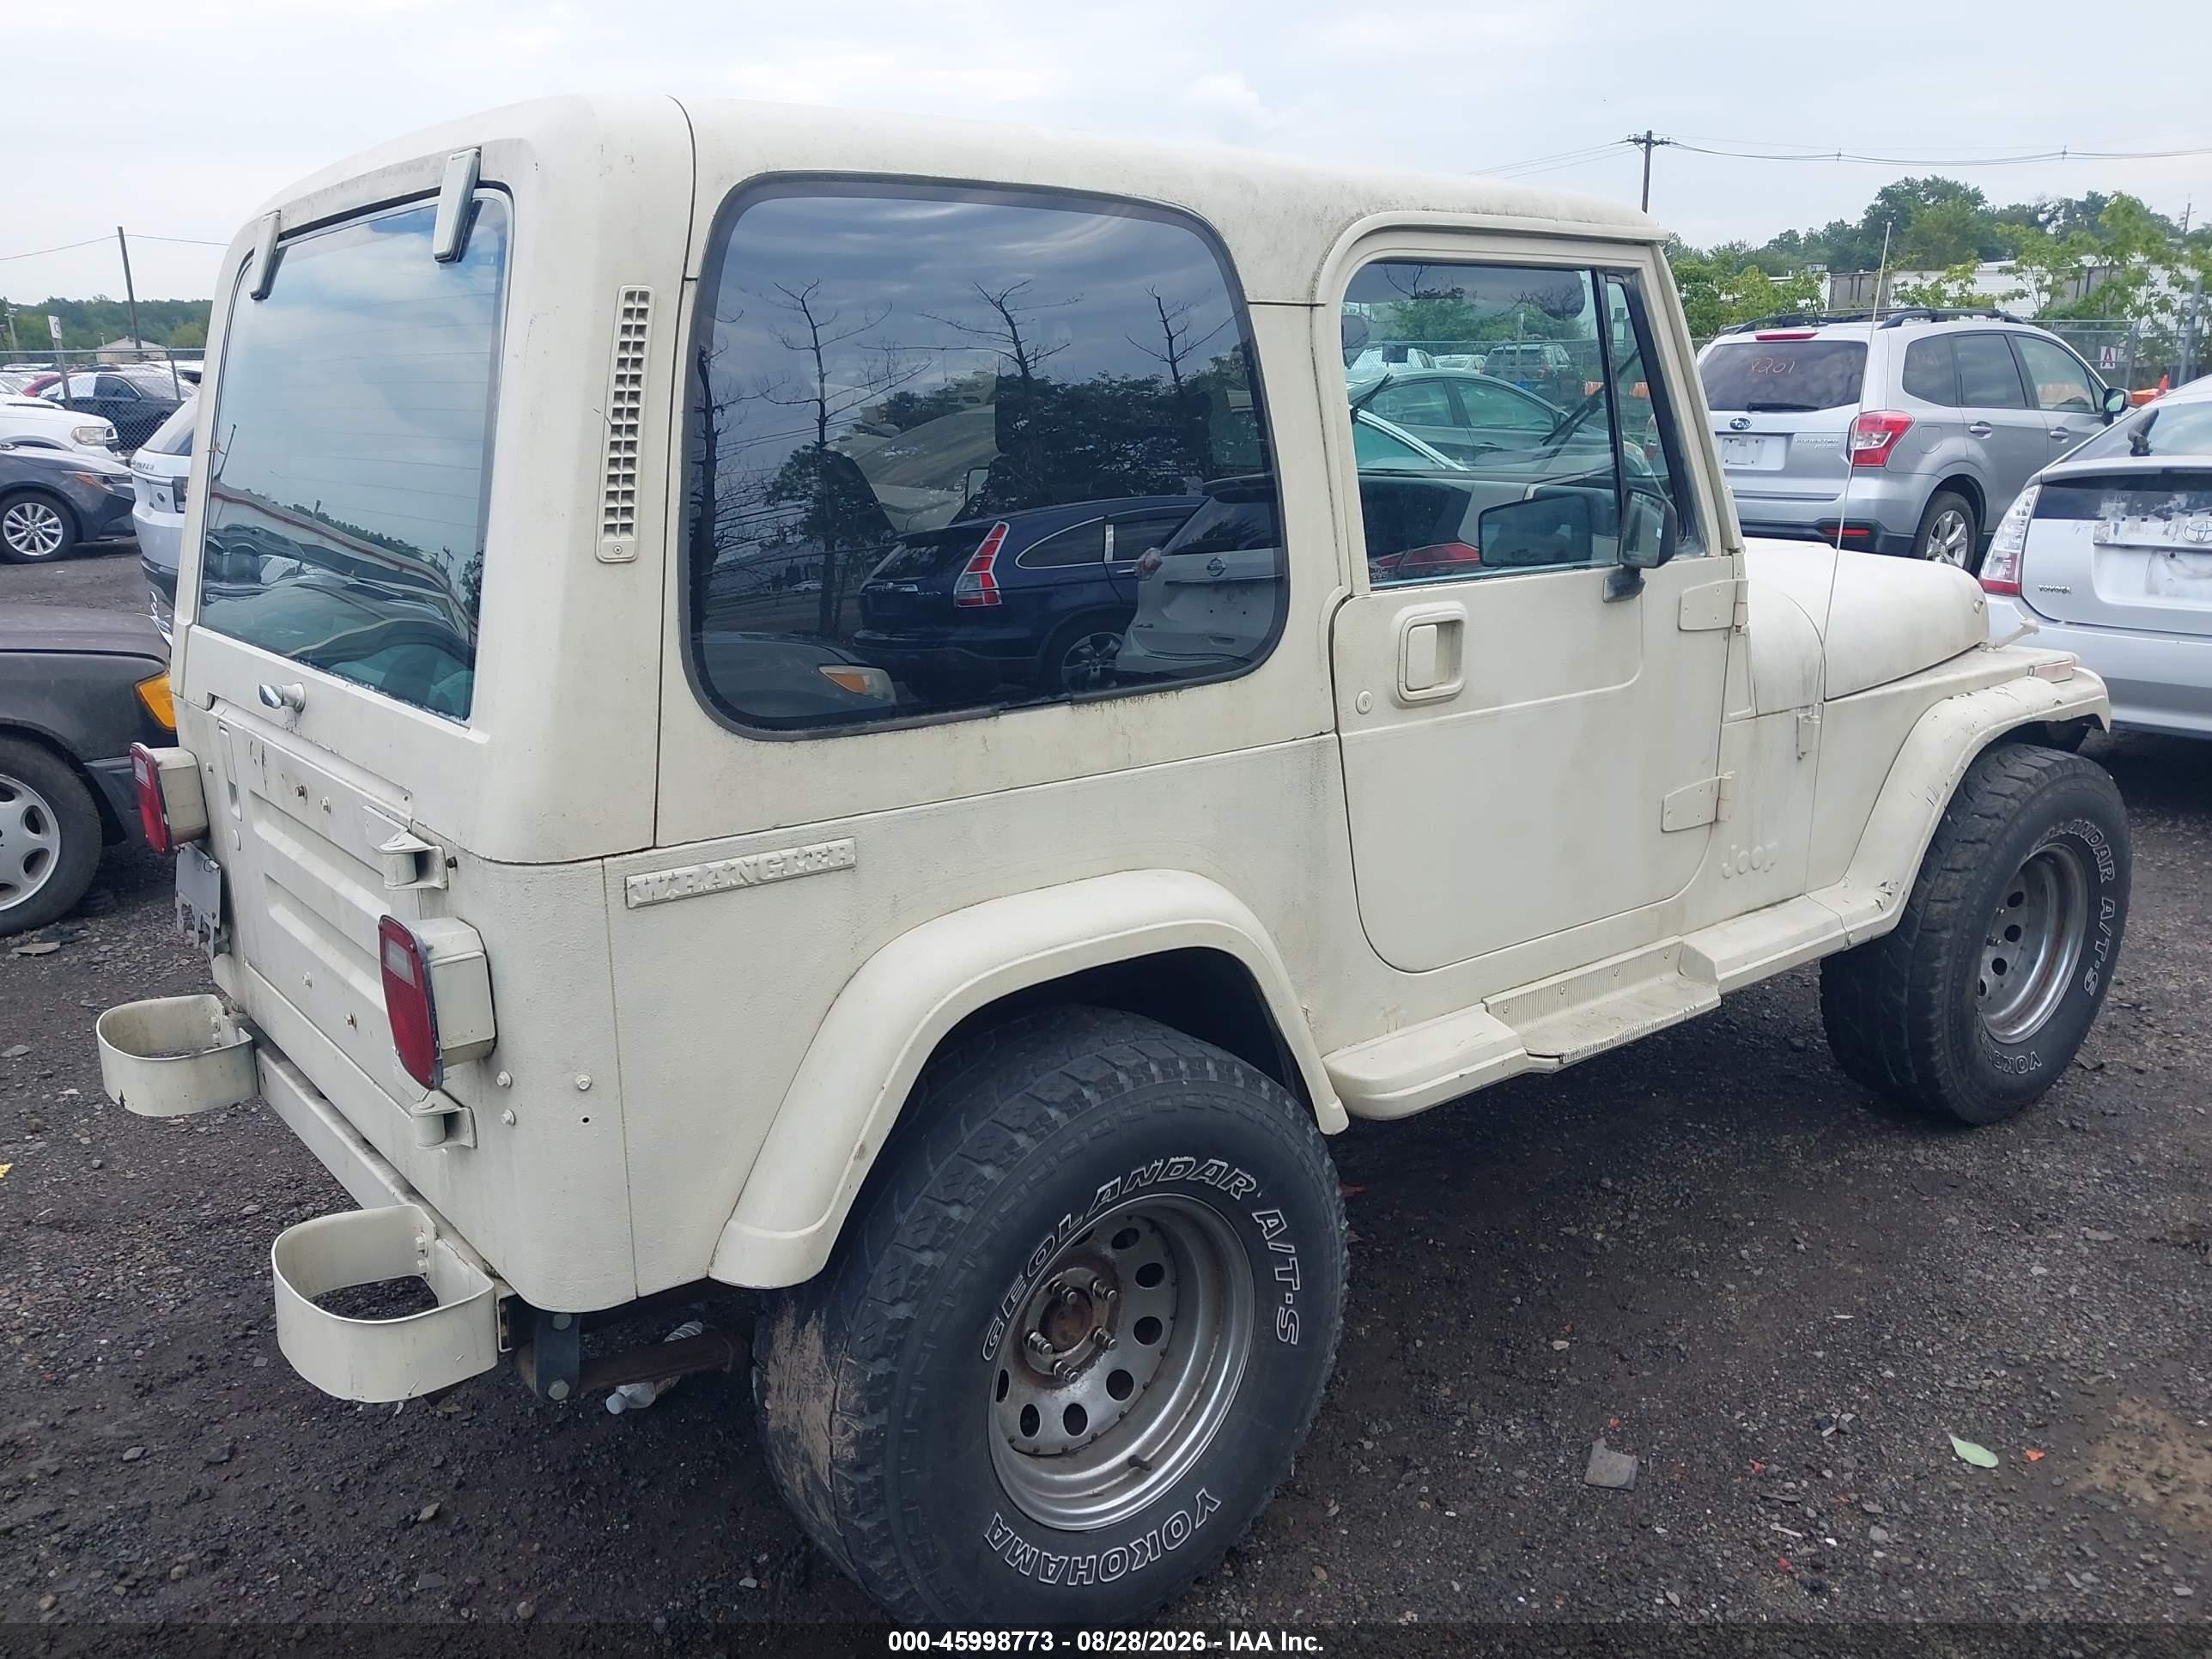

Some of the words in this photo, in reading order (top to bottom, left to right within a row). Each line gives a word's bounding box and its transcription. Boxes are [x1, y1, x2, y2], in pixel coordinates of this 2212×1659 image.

[2102, 346, 2113, 367] A
[982, 1157, 1257, 1362] GEOLANDAR
[983, 1487, 1222, 1586] YOKOHAMA
